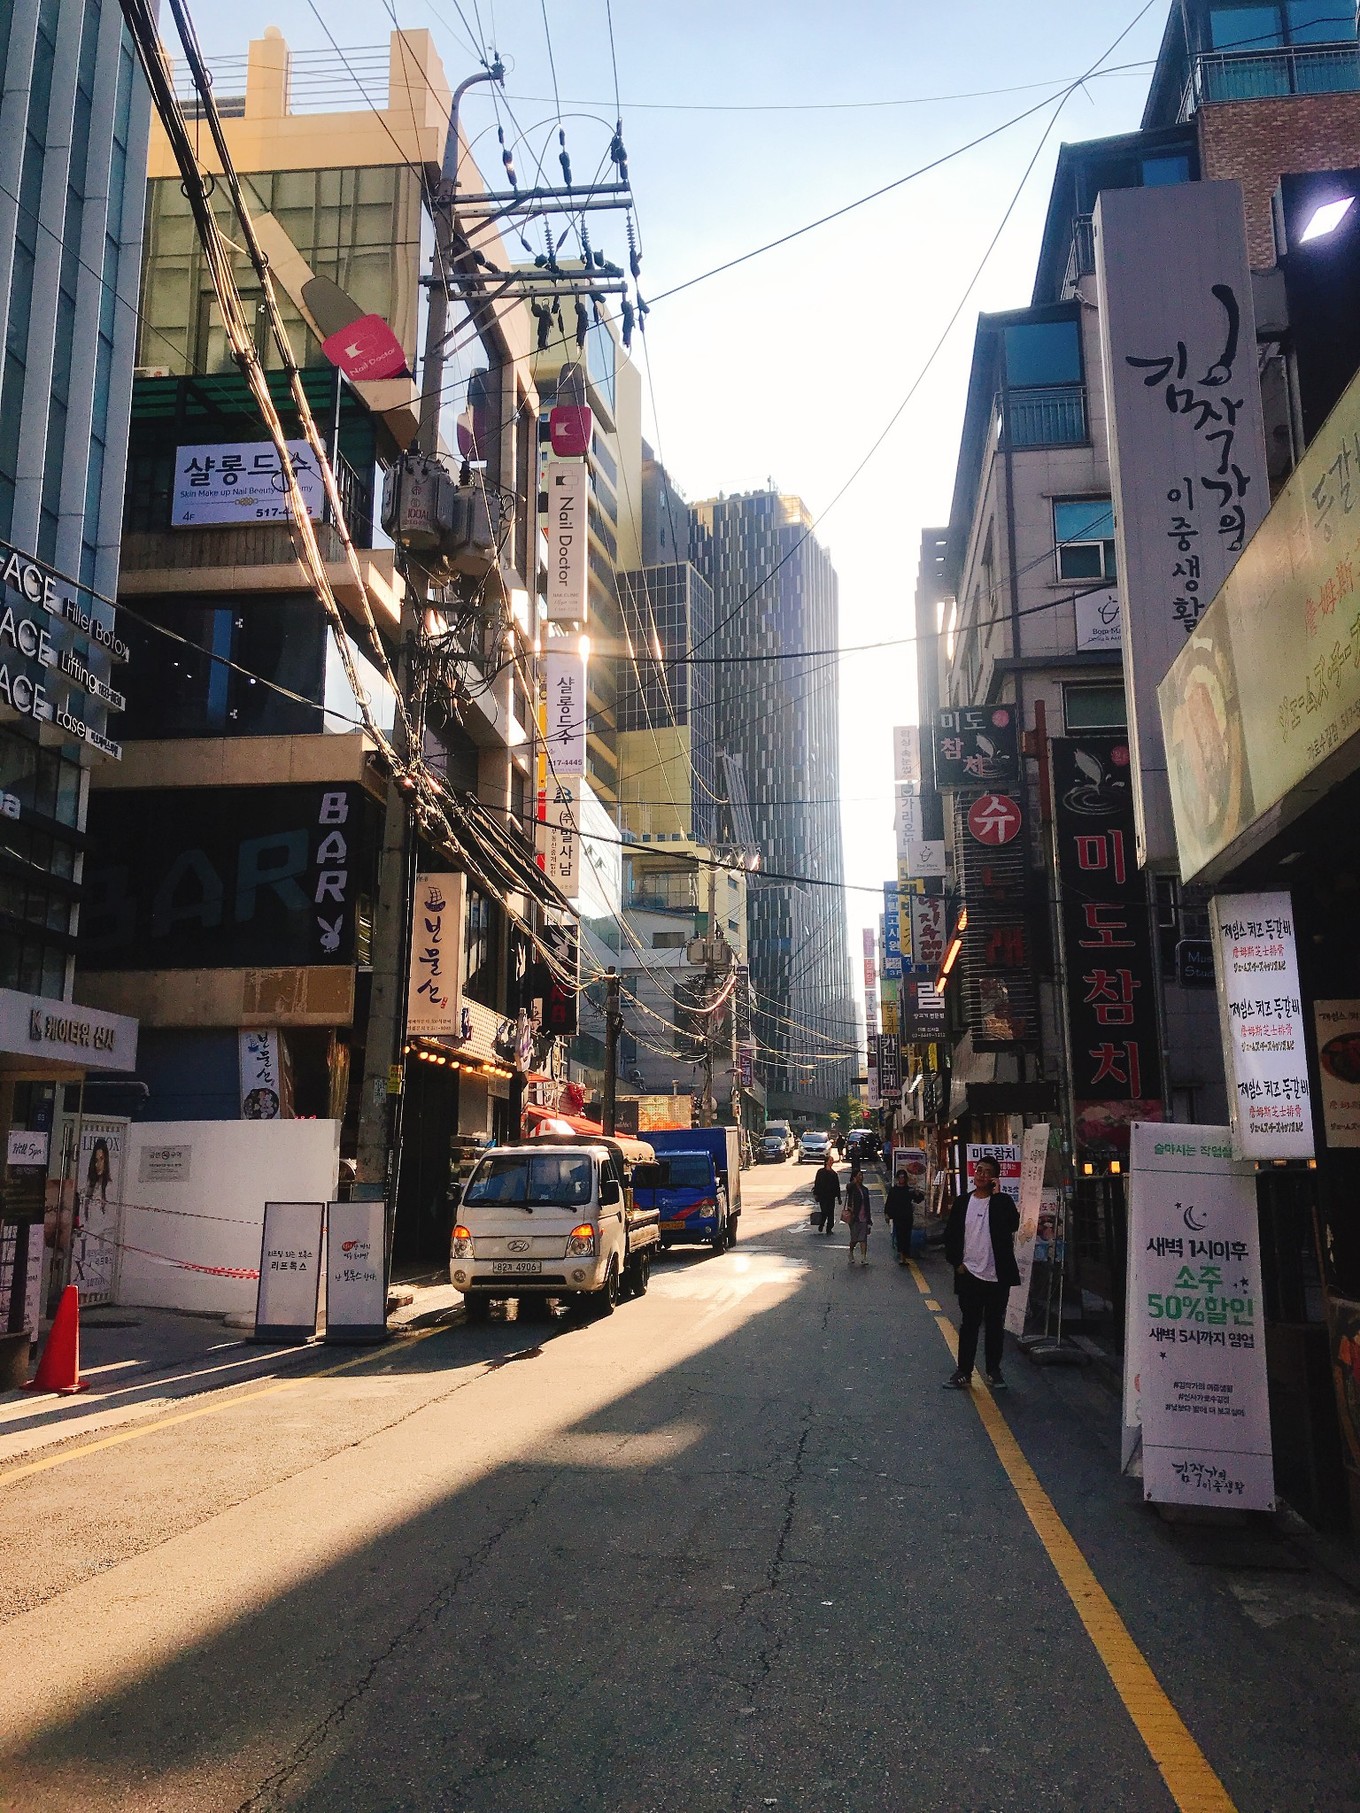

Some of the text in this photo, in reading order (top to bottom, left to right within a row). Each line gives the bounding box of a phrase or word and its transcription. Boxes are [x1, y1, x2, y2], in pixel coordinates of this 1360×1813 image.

[349, 347, 396, 377] Nail Doctor
[1126, 341, 1250, 551] 김작가의
[180, 490, 197, 499] Skin
[198, 489, 219, 498] Make
[220, 489, 232, 498] up
[232, 486, 248, 496] Nail
[249, 485, 275, 495] Beauty
[256, 506, 312, 518] 517-45
[560, 497, 574, 530] Nail
[559, 536, 573, 587] Doctor
[1167, 477, 1205, 632] 이중생활
[0, 552, 57, 615] ACE
[67, 599, 92, 635] Filler
[61, 647, 97, 695] Lifting
[557, 676, 575, 746] 샬롱드수
[941, 711, 987, 734] 미도
[973, 797, 1016, 843] 슈
[315, 792, 349, 904] BAR
[1221, 916, 1292, 941] 제임스 치즈 등갈비
[416, 914, 443, 1004] 보물선
[1074, 829, 1142, 1099] 미도참치
[1185, 965, 1214, 977] Stud
[1187, 951, 1213, 963] Mus
[1229, 997, 1301, 1022] 제임스 치즈 등갈비
[1238, 1076, 1310, 1102] 제임스 치즈 등갈비
[1153, 1142, 1197, 1158] 술마시는
[1146, 1237, 1249, 1261] 새벽 1시이후
[271, 1261, 308, 1271] 리프톡스
[515, 1262, 537, 1271] 4906
[1174, 1265, 1224, 1295] 소주
[1147, 1294, 1255, 1327] 50%할인
[1148, 1327, 1255, 1349] 새벽 5시까지 영업
[1171, 1460, 1227, 1488] 김작가의
[1202, 1479, 1246, 1495] 이중생활
